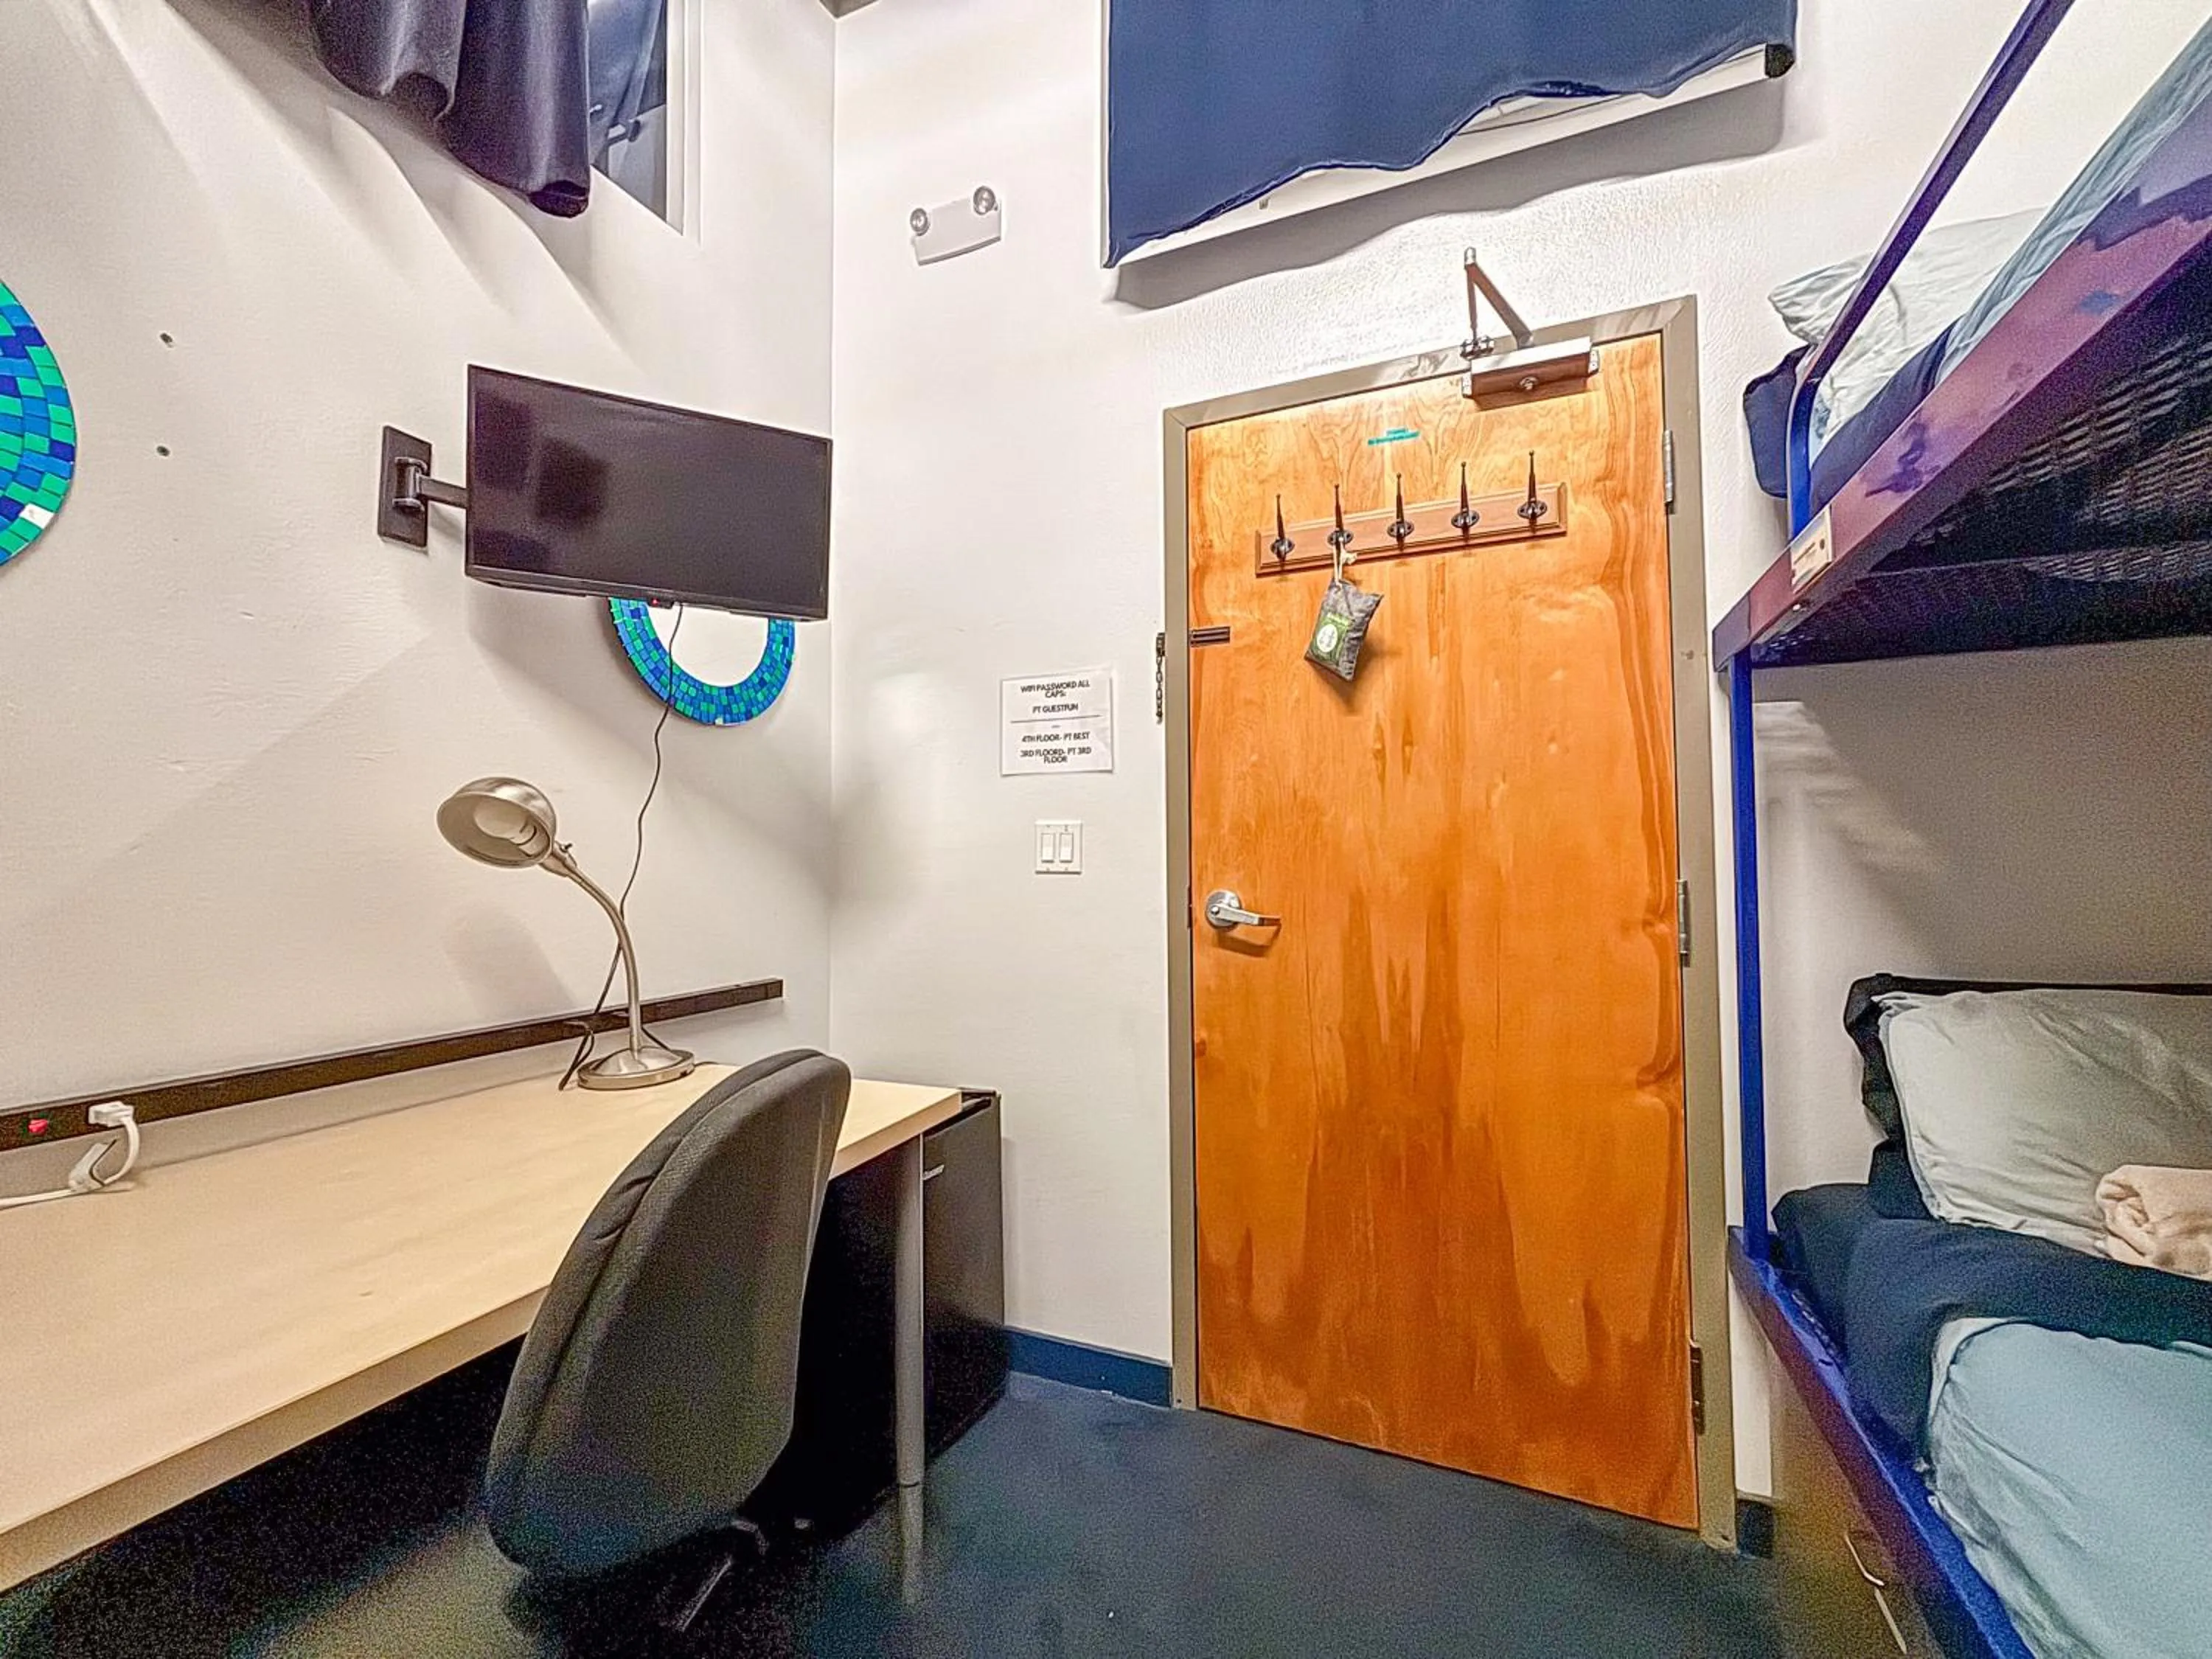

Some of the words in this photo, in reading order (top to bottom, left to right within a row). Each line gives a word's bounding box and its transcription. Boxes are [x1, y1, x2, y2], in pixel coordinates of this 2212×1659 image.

[1037, 681, 1077, 691] PASSWORD
[1078, 679, 1090, 687] ALL
[1074, 731, 1091, 740] BEST
[1068, 747, 1077, 755] PT
[1078, 746, 1091, 755] 3RD
[1044, 755, 1068, 764] FLOOR
